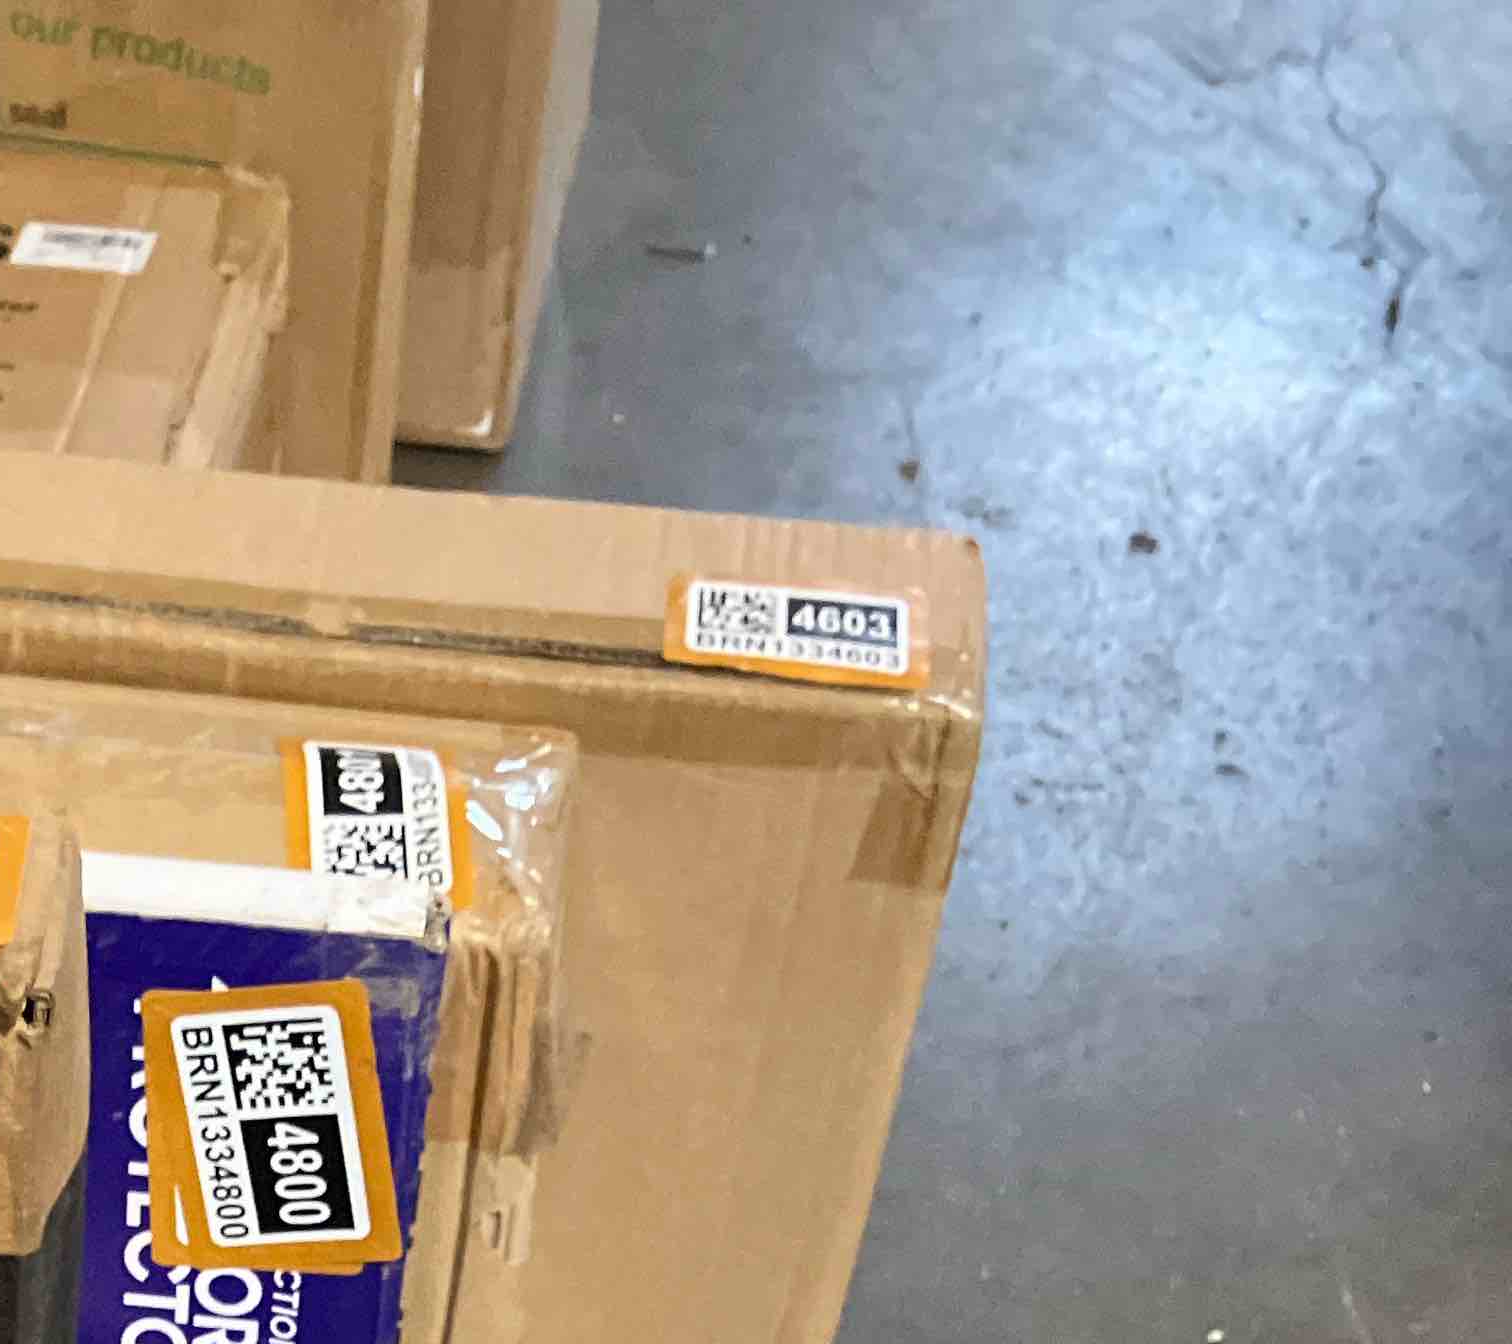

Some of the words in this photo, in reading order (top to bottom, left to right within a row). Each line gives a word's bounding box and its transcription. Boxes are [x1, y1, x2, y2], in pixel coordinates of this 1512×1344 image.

[10, 10, 80, 45] our
[90, 24, 271, 97] products
[791, 603, 891, 639] 4603
[408, 772, 445, 889] BRN133
[180, 1025, 251, 1240] BRN1334800
[266, 1120, 333, 1227] 4800
